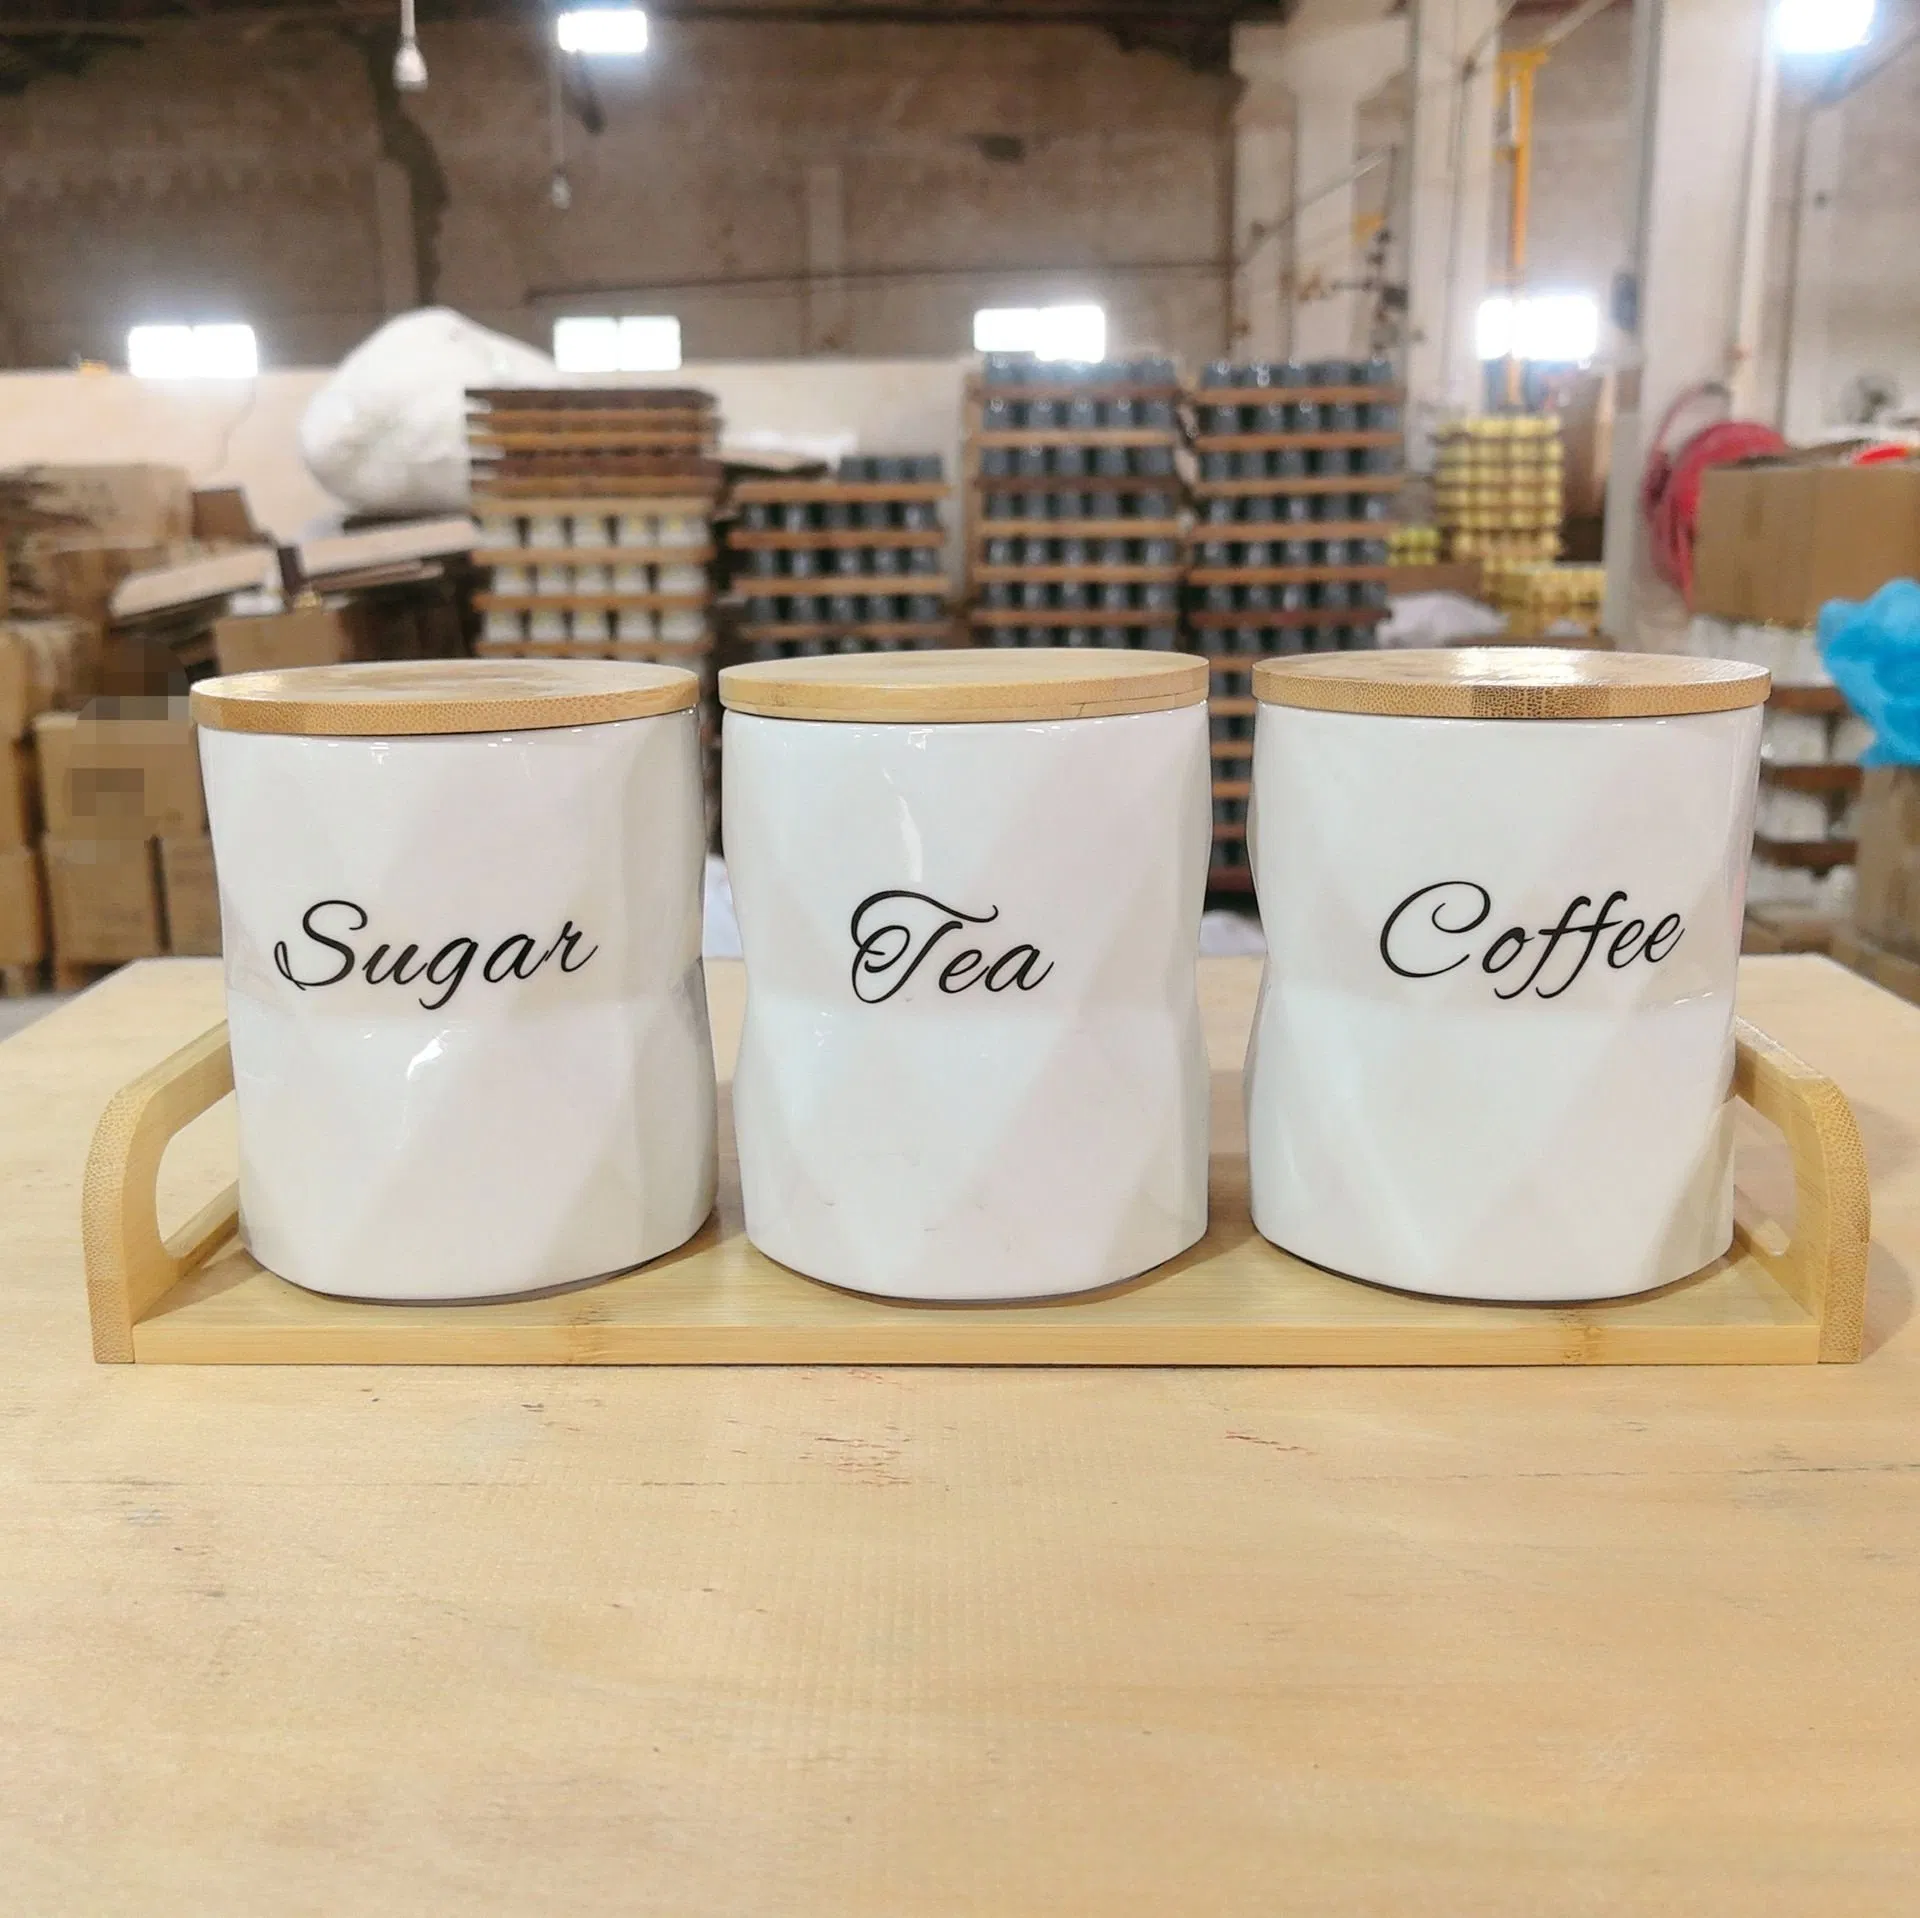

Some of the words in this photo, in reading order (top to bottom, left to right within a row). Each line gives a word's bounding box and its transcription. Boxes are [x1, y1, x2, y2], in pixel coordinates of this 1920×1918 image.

[273, 899, 600, 1011] Sugar
[850, 889, 1055, 1005] Tea
[1379, 880, 1686, 1001] Coffee
